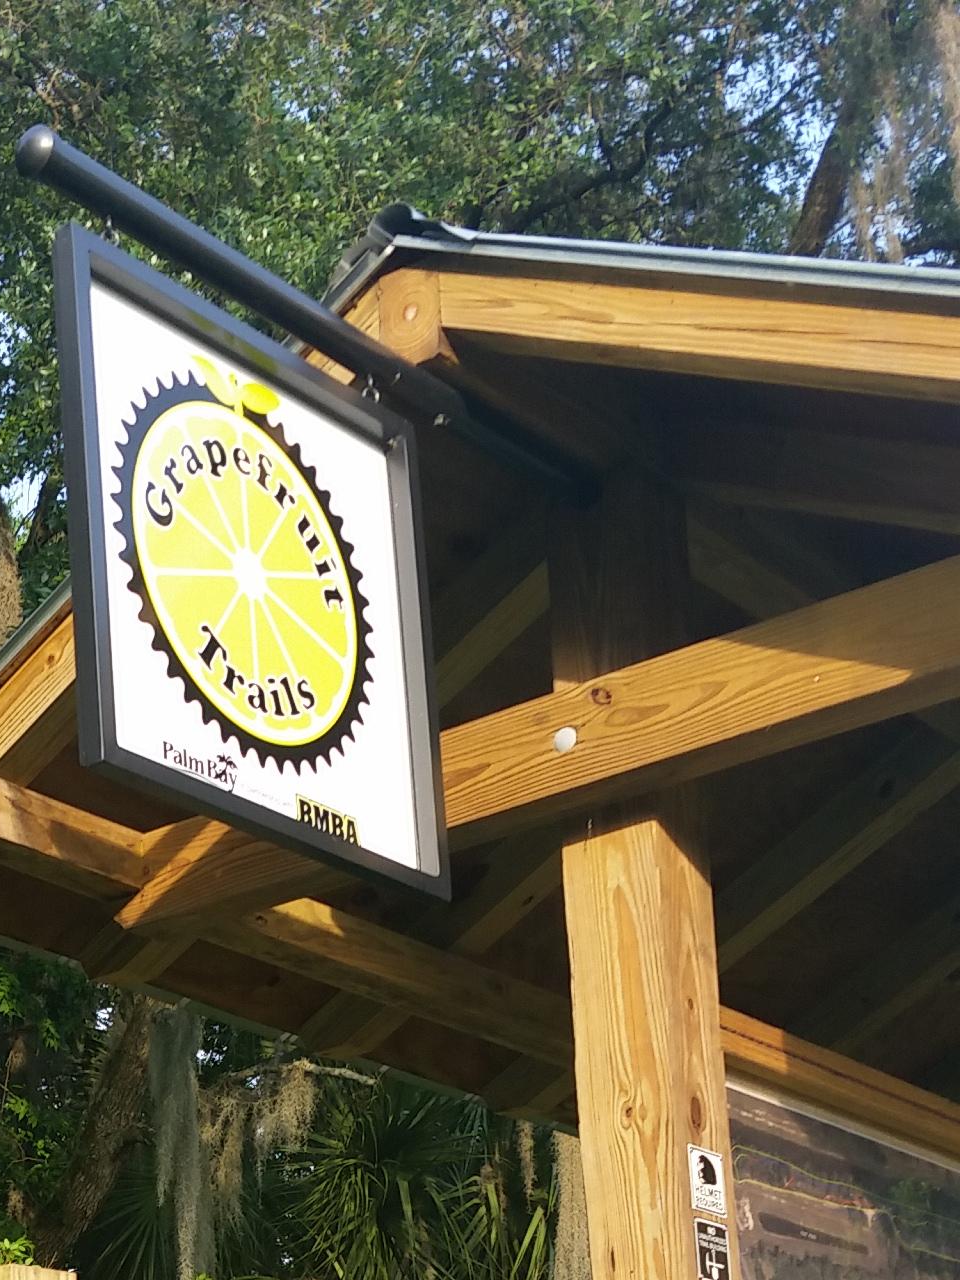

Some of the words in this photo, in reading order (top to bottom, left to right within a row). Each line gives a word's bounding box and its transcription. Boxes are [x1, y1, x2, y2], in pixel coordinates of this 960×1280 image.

[144, 439, 346, 610] Grapefruit
[195, 625, 317, 718] Trails
[163, 741, 205, 775] Palm
[298, 798, 359, 846] BMBA
